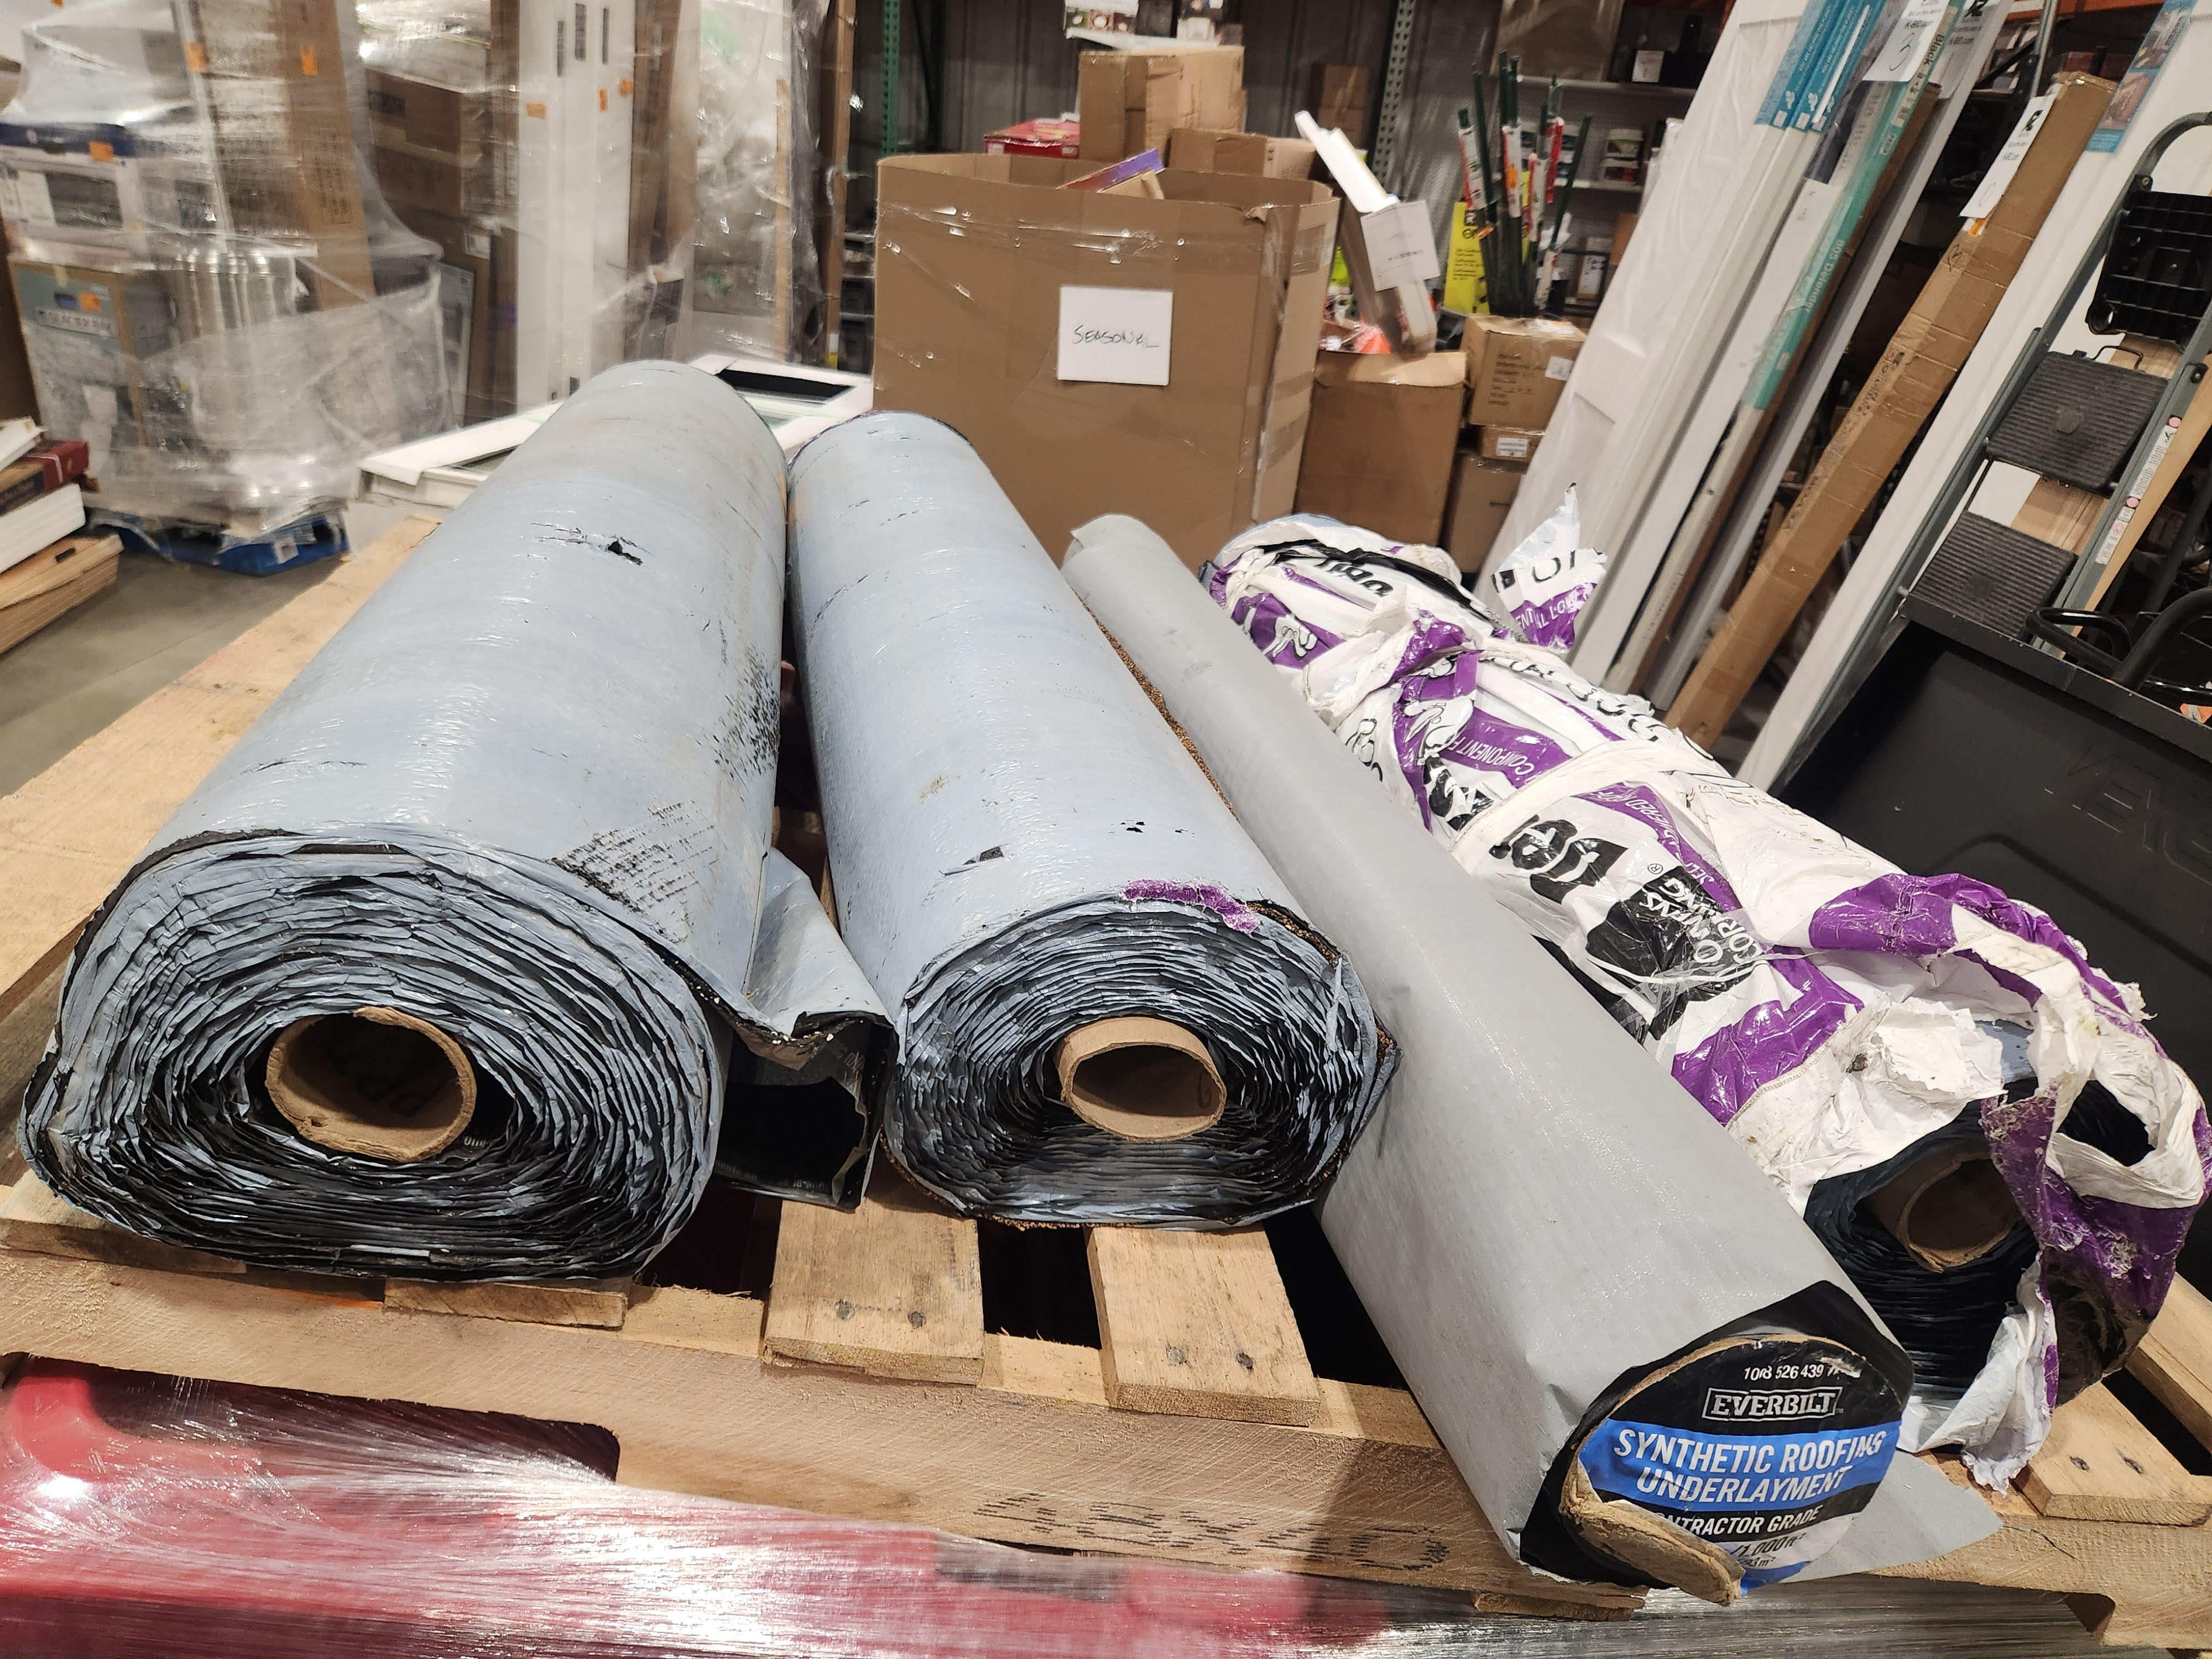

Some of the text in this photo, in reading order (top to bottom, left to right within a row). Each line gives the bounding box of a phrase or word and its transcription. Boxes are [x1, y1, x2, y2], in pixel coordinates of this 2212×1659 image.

[1456, 739, 1535, 775] COMPONENT
[1775, 1365, 1799, 1379] 526
[1801, 1364, 1825, 1379] 439
[1713, 1391, 1836, 1417] EVERBILT
[1613, 1428, 1887, 1474] SYNTHETIC ROOFING
[1636, 1465, 1854, 1503] UNDERLAYMENT
[1767, 1504, 1824, 1532] GRADE
